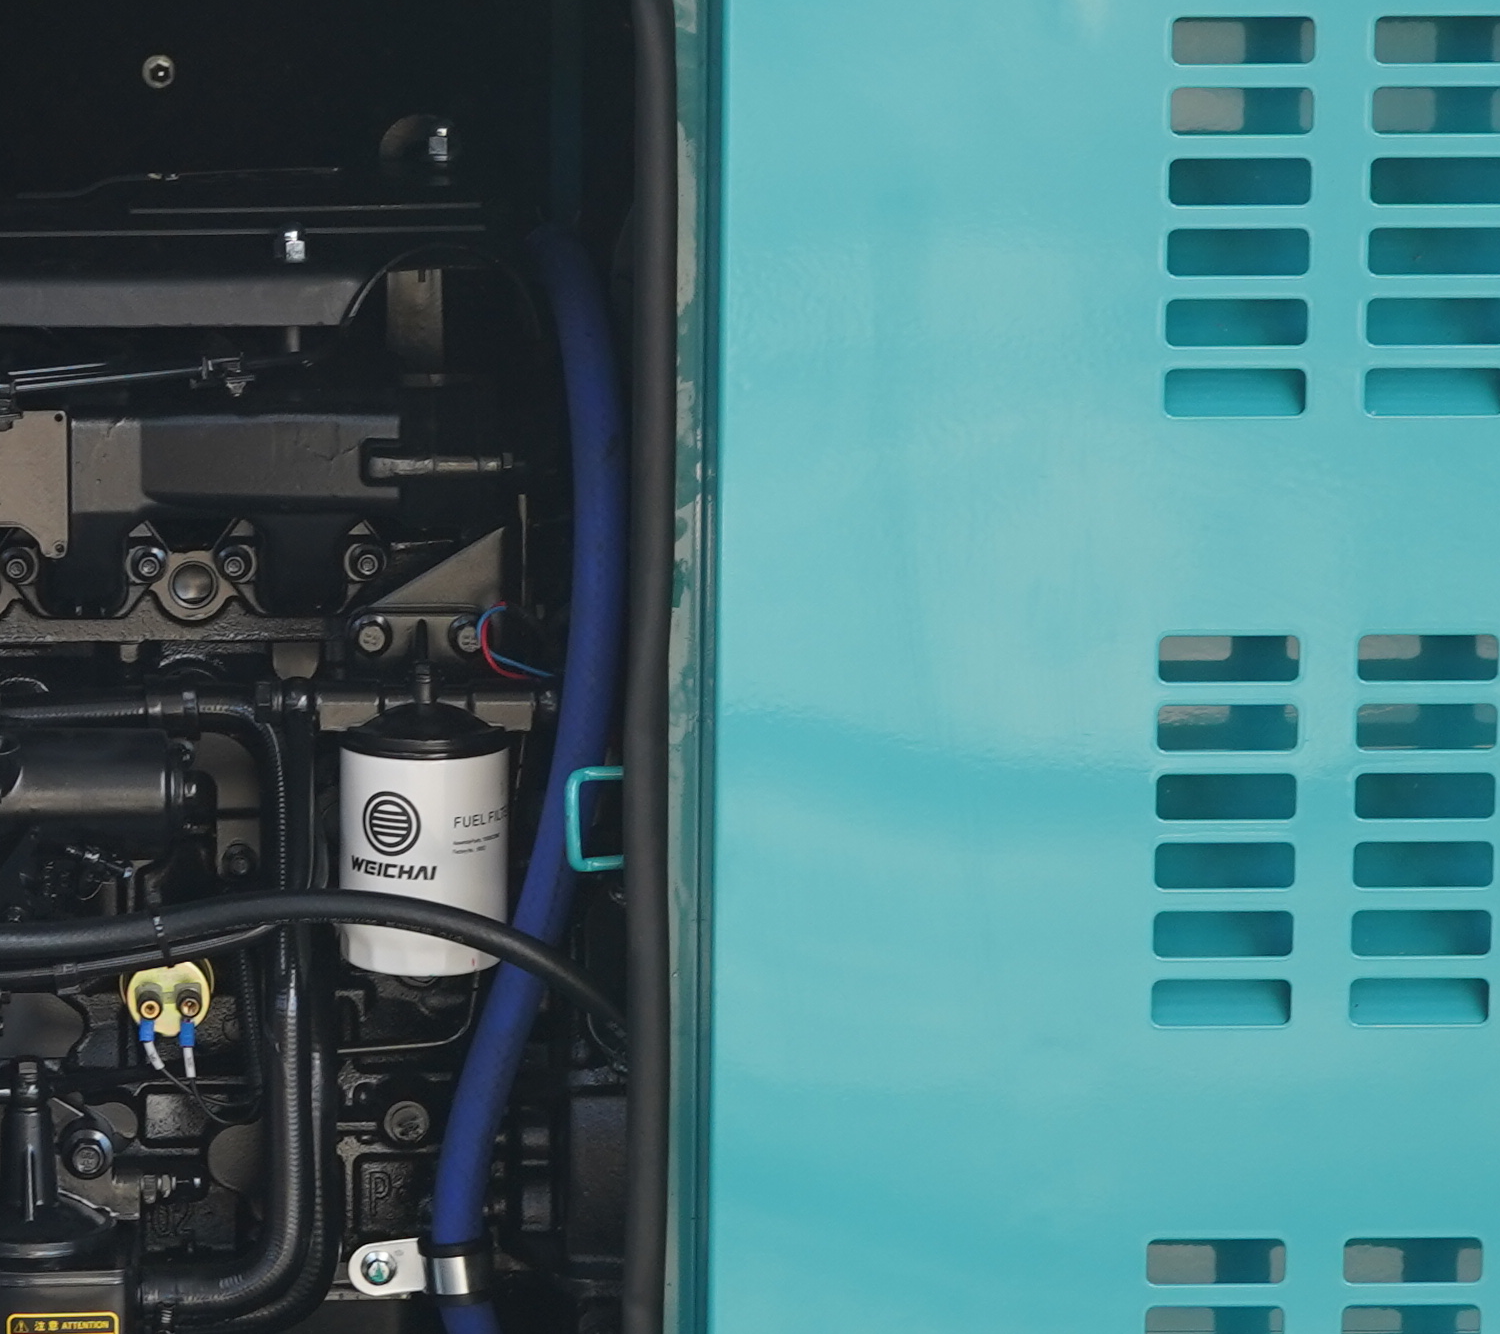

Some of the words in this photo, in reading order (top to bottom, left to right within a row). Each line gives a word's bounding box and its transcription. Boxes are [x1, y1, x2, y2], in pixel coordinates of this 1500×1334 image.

[453, 812, 486, 829] FUEL
[351, 854, 438, 880] WEICHAI
[61, 1320, 110, 1331] ATTENTION
